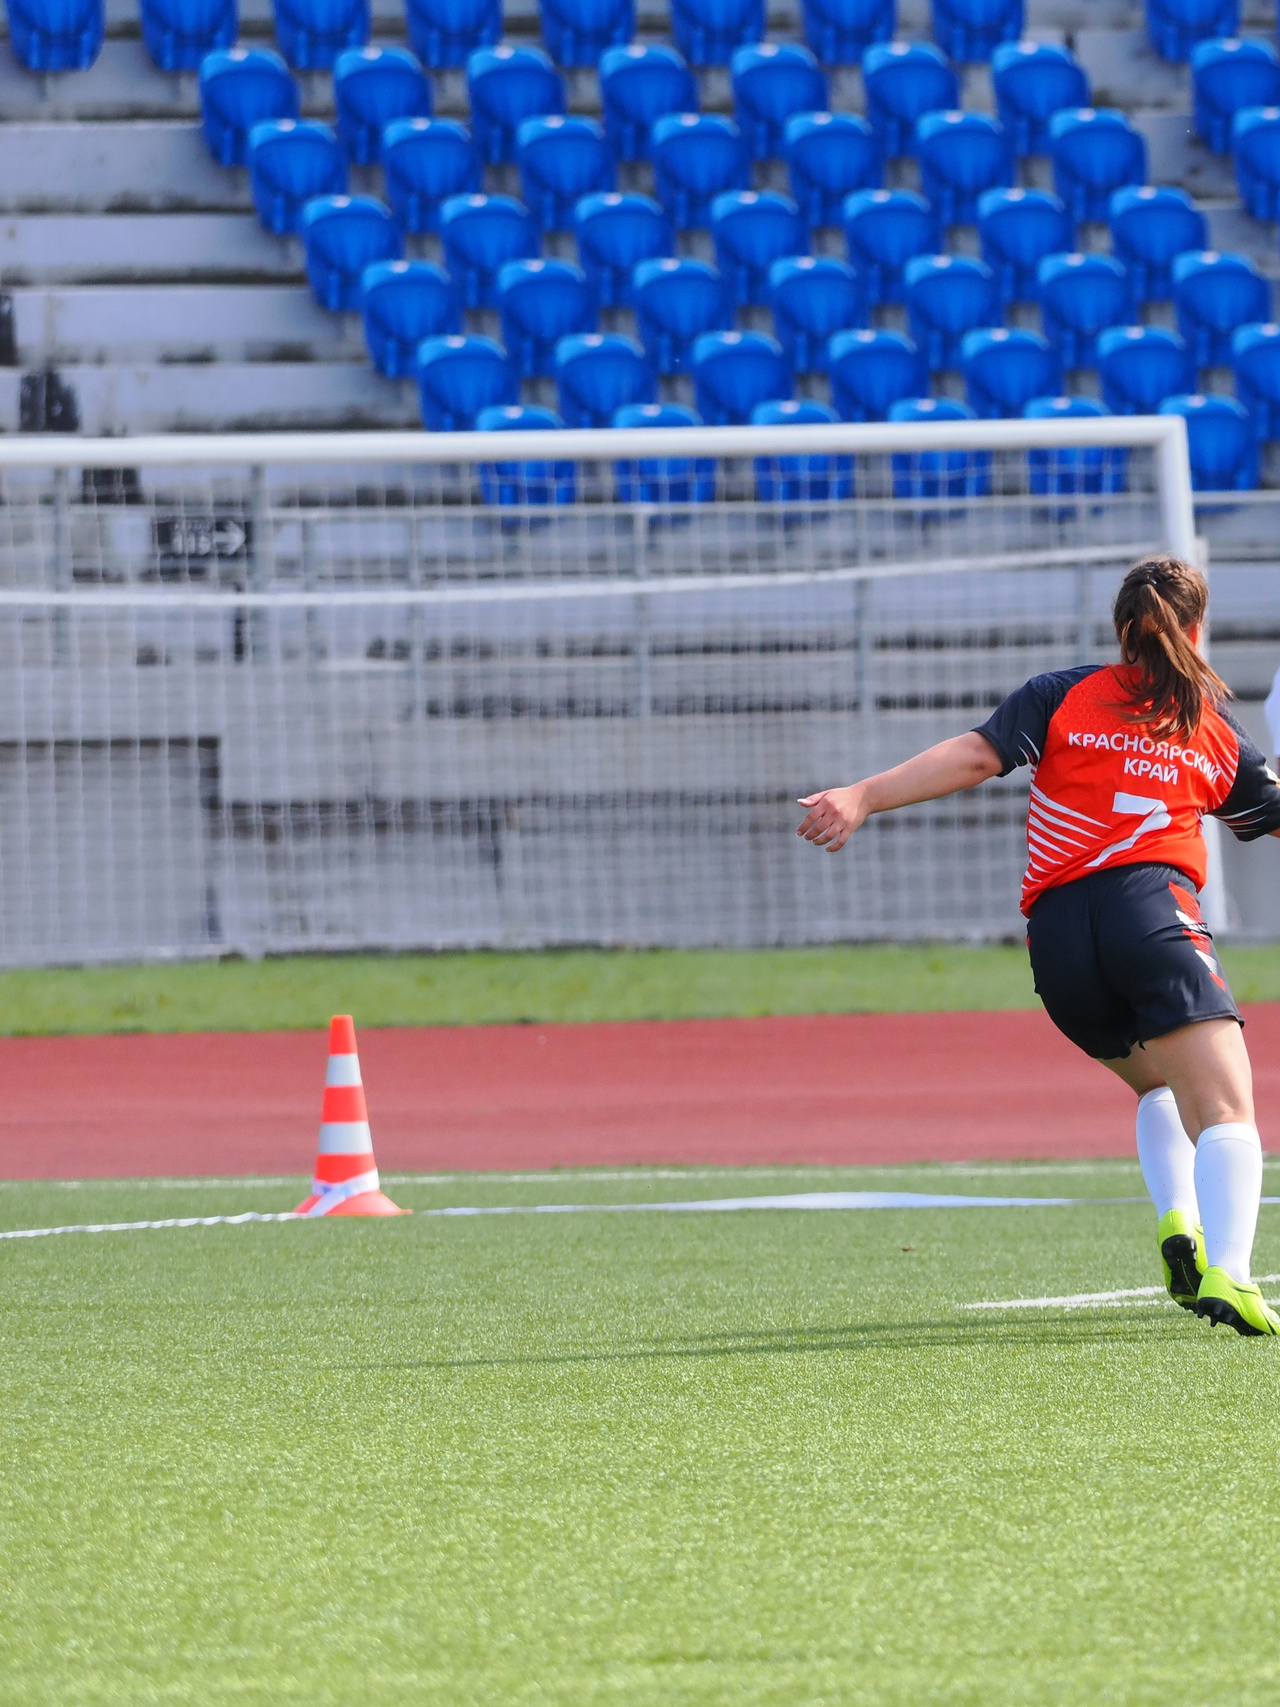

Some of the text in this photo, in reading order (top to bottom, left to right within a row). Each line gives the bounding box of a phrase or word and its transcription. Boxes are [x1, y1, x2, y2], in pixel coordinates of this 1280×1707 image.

[1068, 732, 1222, 785] КРАСНОЯРСКИЙ
[1123, 757, 1179, 786] КРАЙ
[1083, 791, 1172, 867] 7
